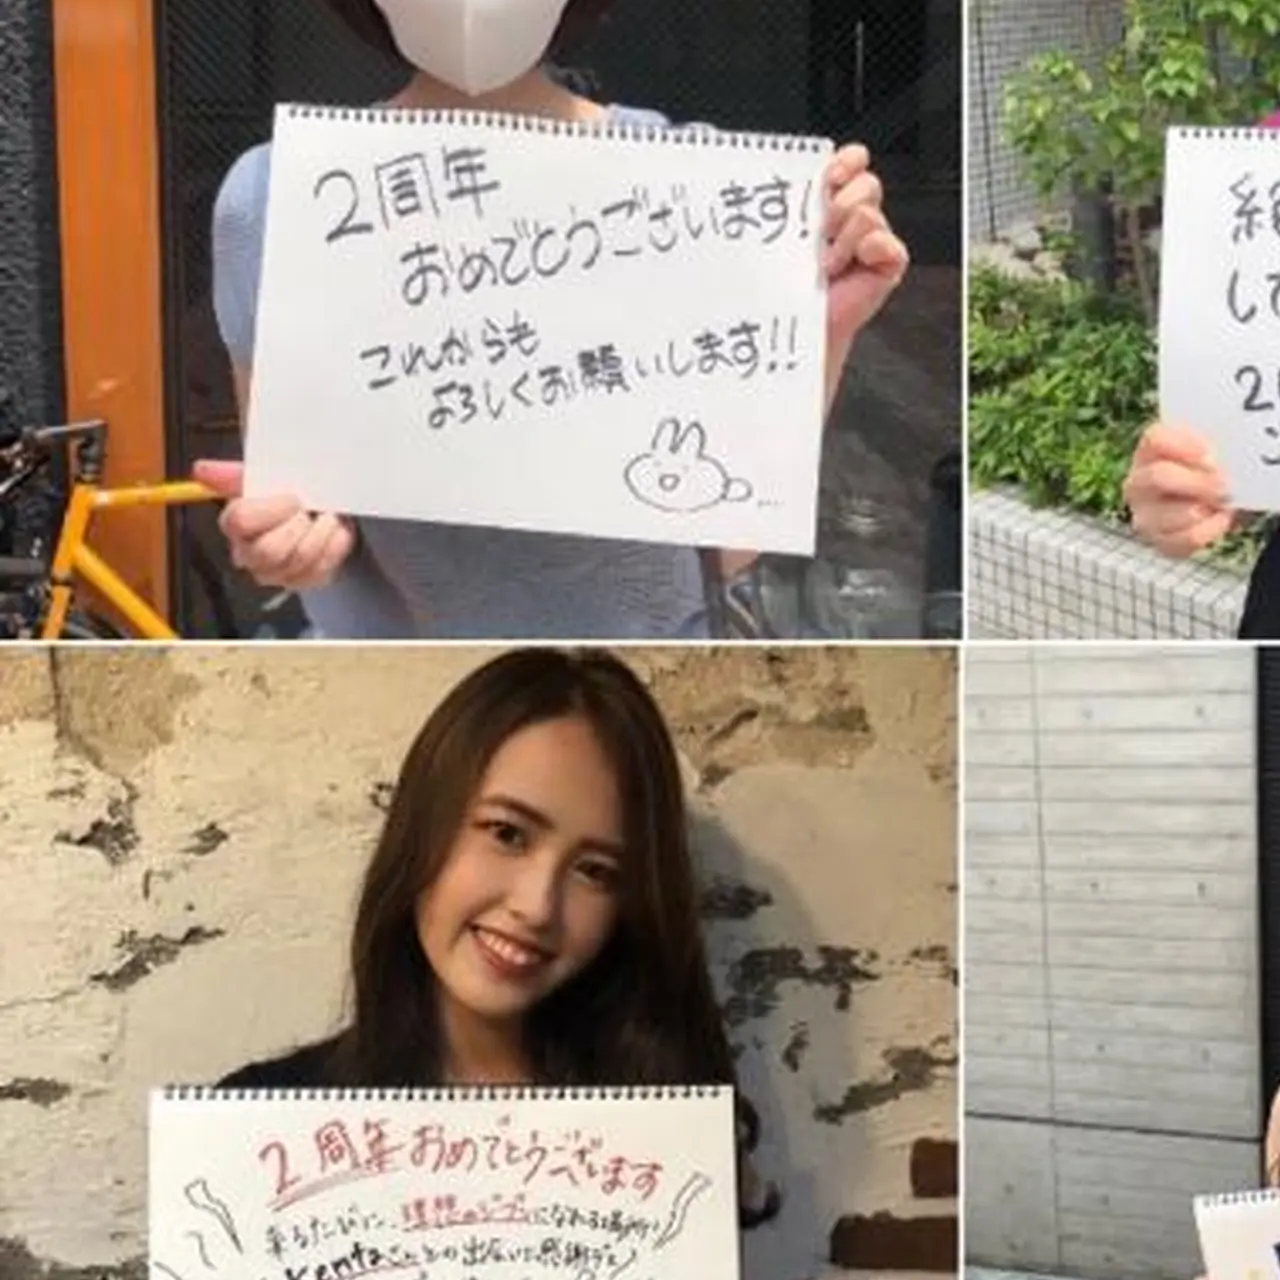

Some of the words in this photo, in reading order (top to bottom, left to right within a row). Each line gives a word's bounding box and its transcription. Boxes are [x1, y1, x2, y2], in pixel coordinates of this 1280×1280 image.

[312, 145, 500, 244] 2周年
[399, 176, 813, 308] おめでとうございます!
[359, 310, 541, 390] これからも
[427, 316, 799, 431] よろしくお願いします!!
